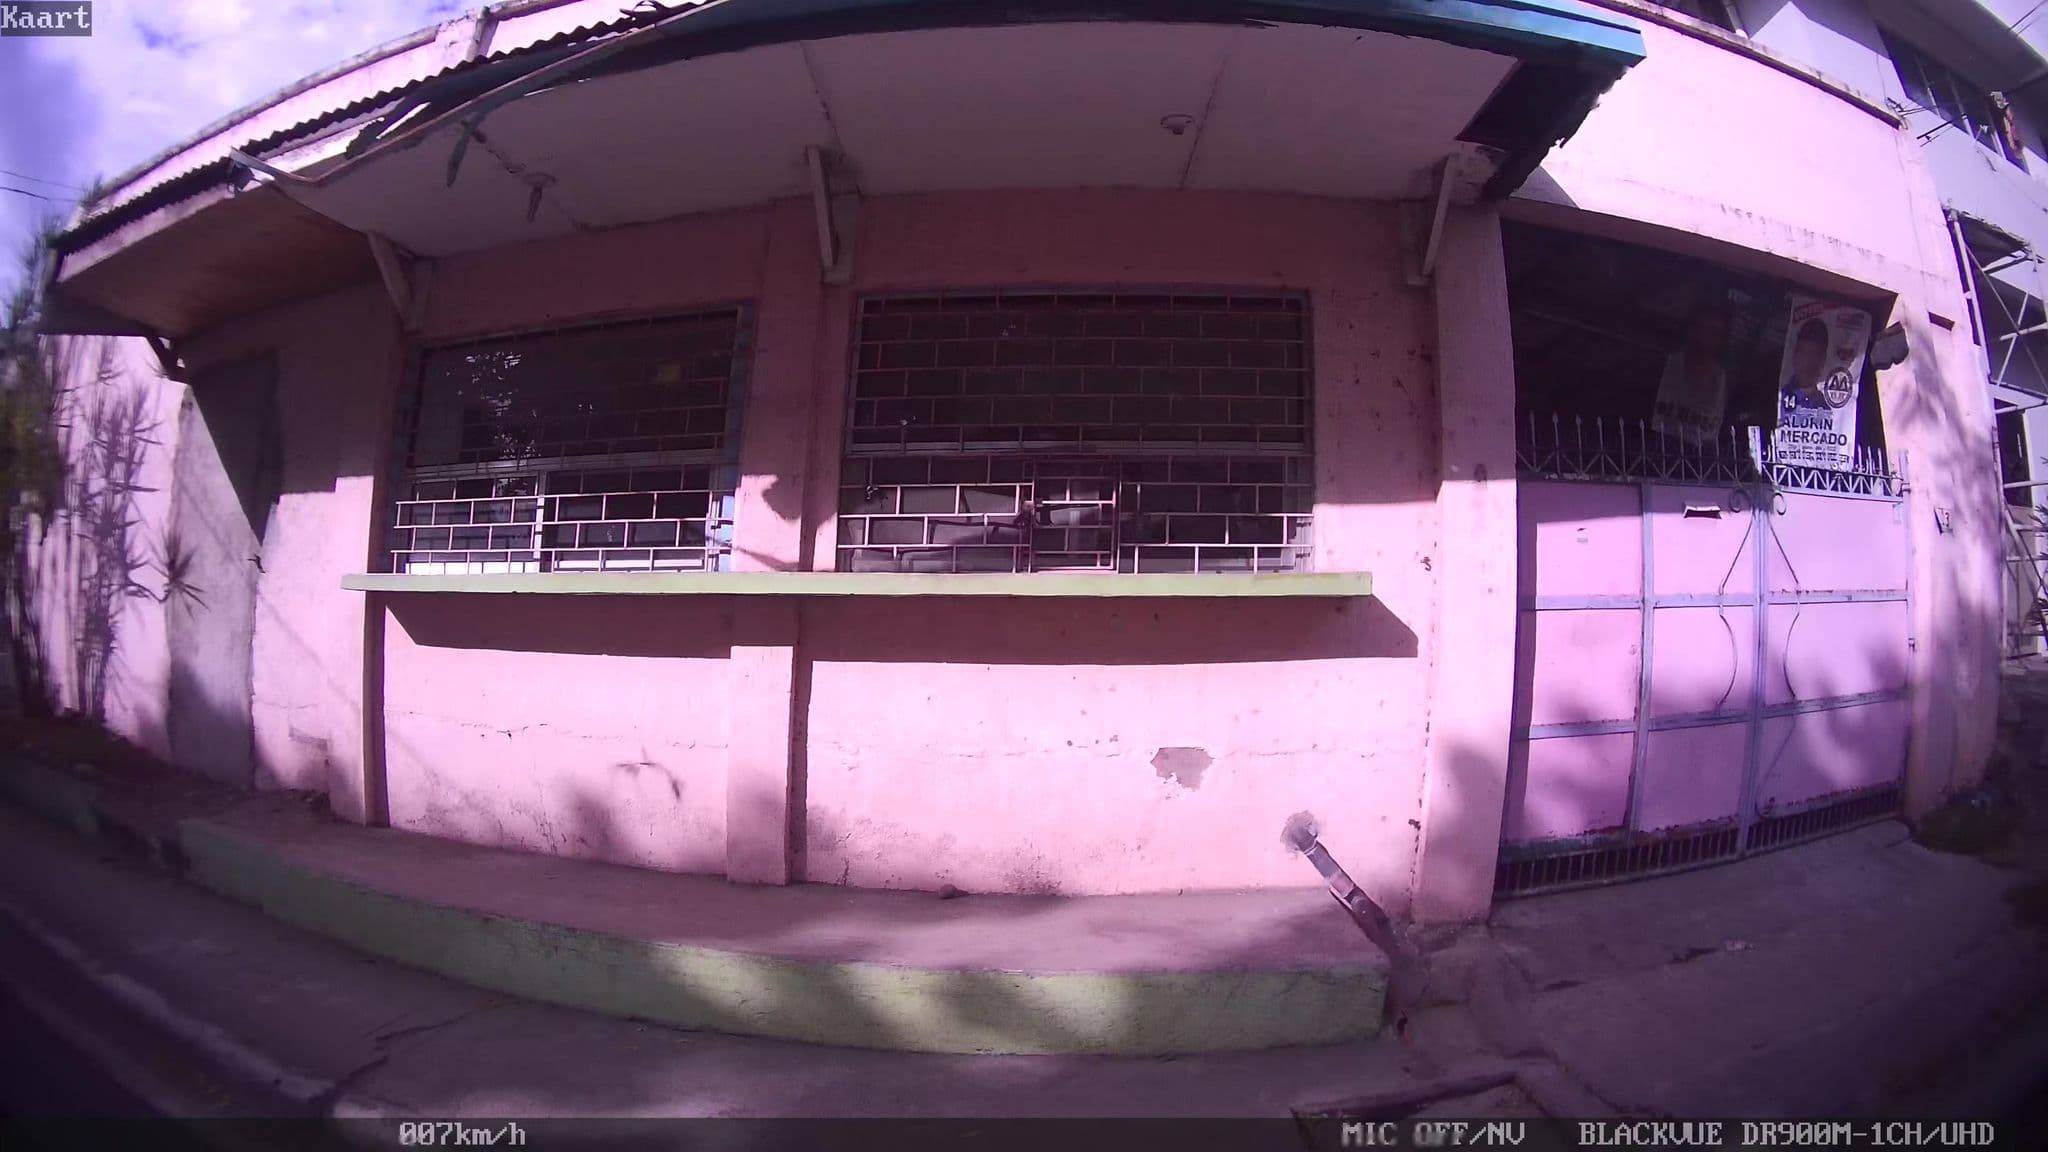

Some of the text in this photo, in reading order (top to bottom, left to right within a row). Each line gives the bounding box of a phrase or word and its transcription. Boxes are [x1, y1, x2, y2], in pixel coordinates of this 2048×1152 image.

[1783, 395, 1796, 409] 14
[1783, 415, 1833, 431] ALDRIN
[1780, 430, 1848, 446] MERCADO
